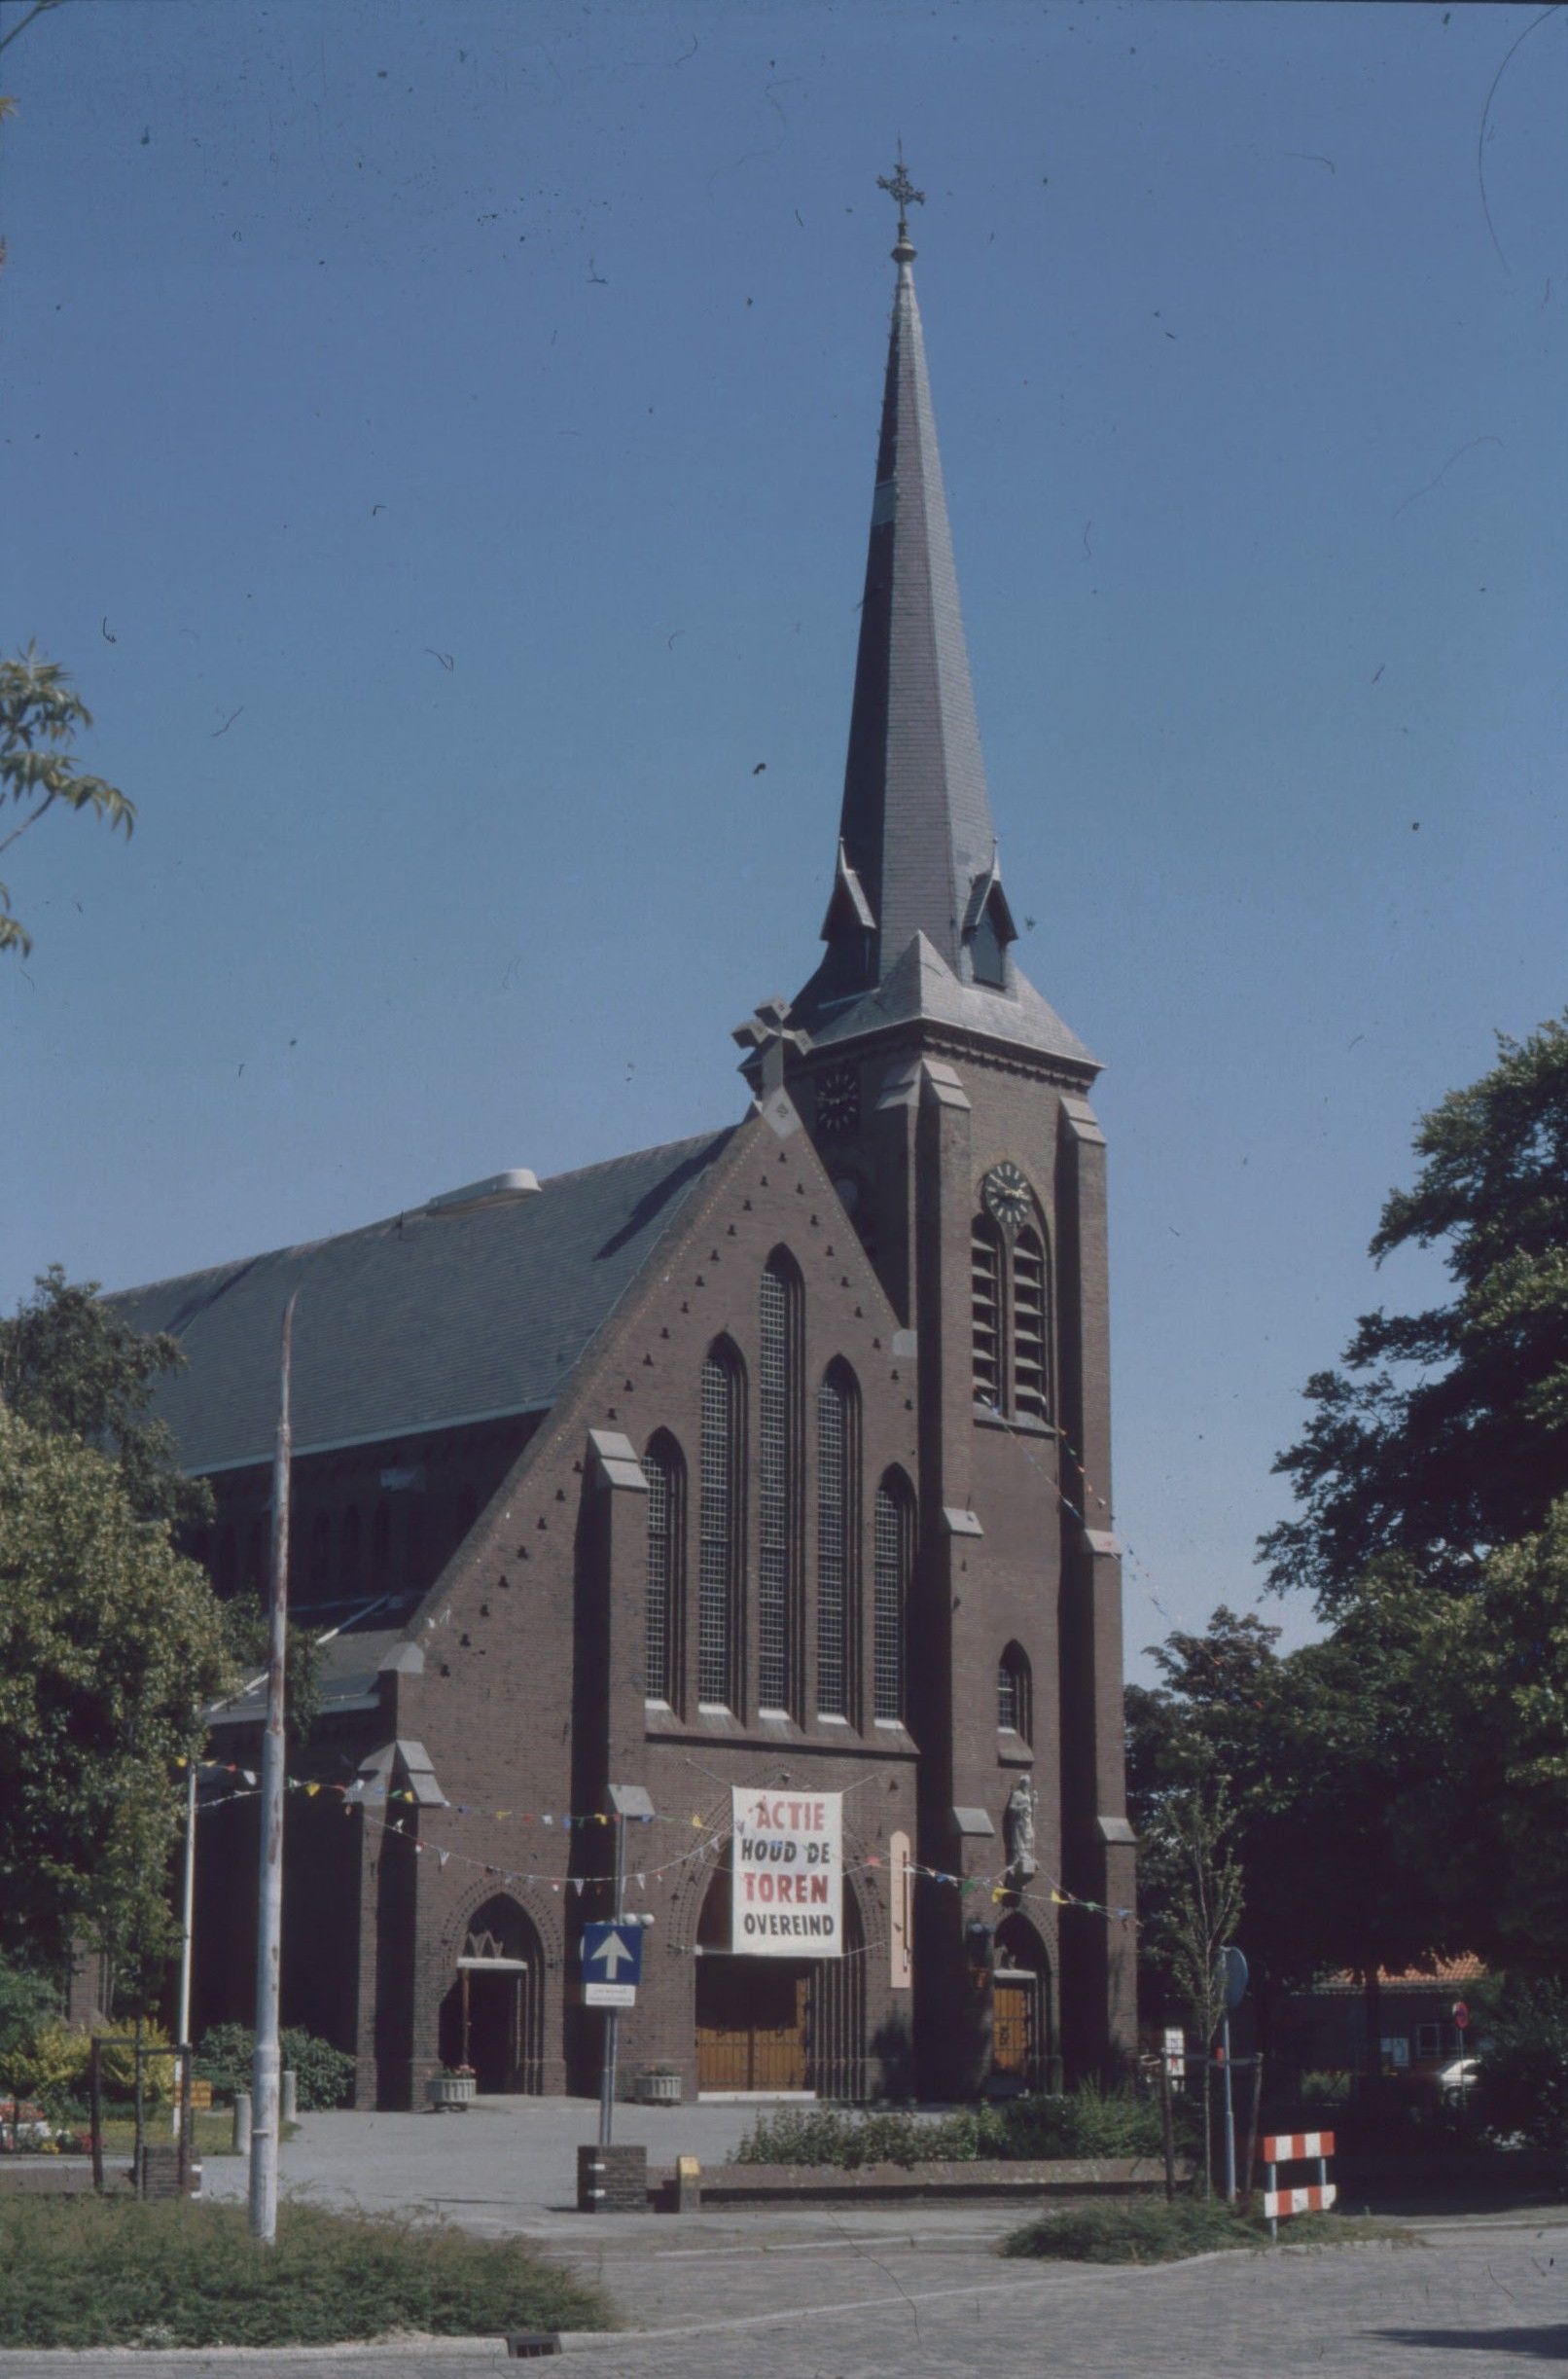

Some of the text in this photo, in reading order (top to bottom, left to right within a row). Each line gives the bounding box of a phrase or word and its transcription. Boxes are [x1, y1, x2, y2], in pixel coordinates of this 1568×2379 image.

[757, 1801, 825, 1831] ACTIE
[741, 1838, 831, 1864] HOUD DE
[743, 1872, 828, 1903] TOREN
[744, 1913, 835, 1935] OVEREIND
